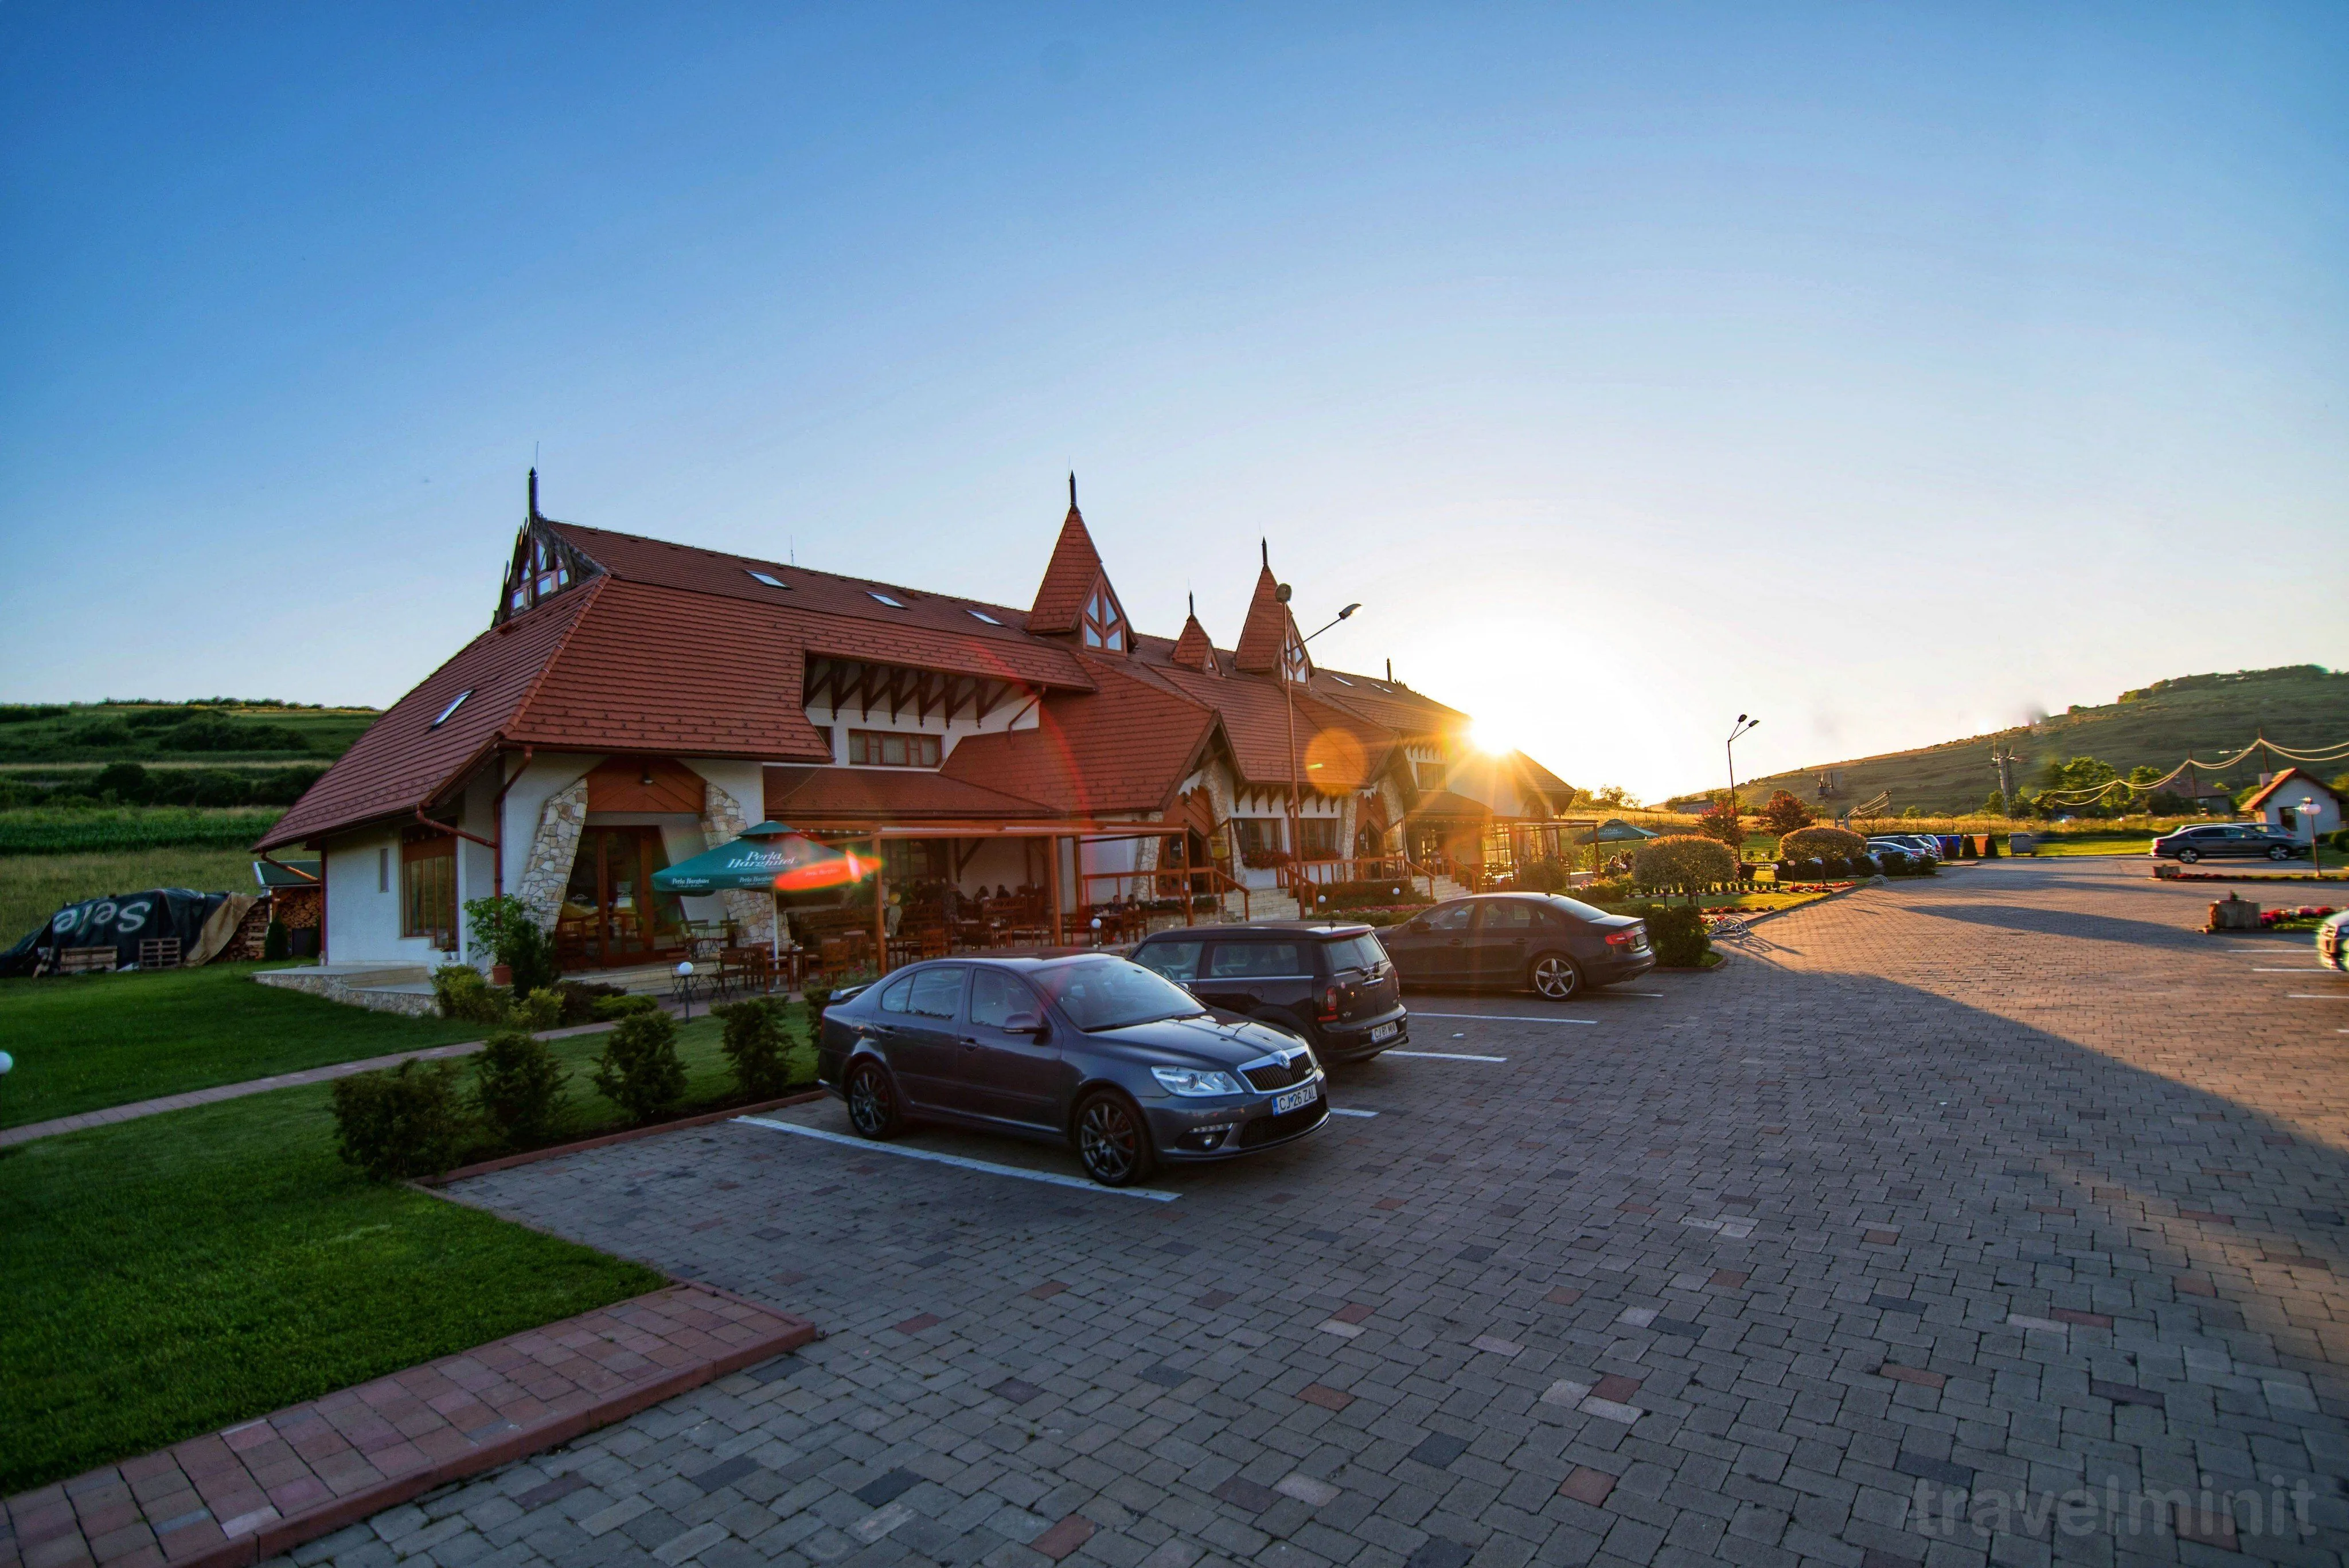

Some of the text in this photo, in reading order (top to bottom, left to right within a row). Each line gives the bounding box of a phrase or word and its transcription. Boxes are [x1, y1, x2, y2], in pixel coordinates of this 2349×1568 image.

[747, 851, 783, 861] Perla
[727, 856, 797, 868] Harghitei
[1375, 1027, 1382, 1038] CJ
[1279, 1087, 1316, 1110] CJ 26 ZAL
